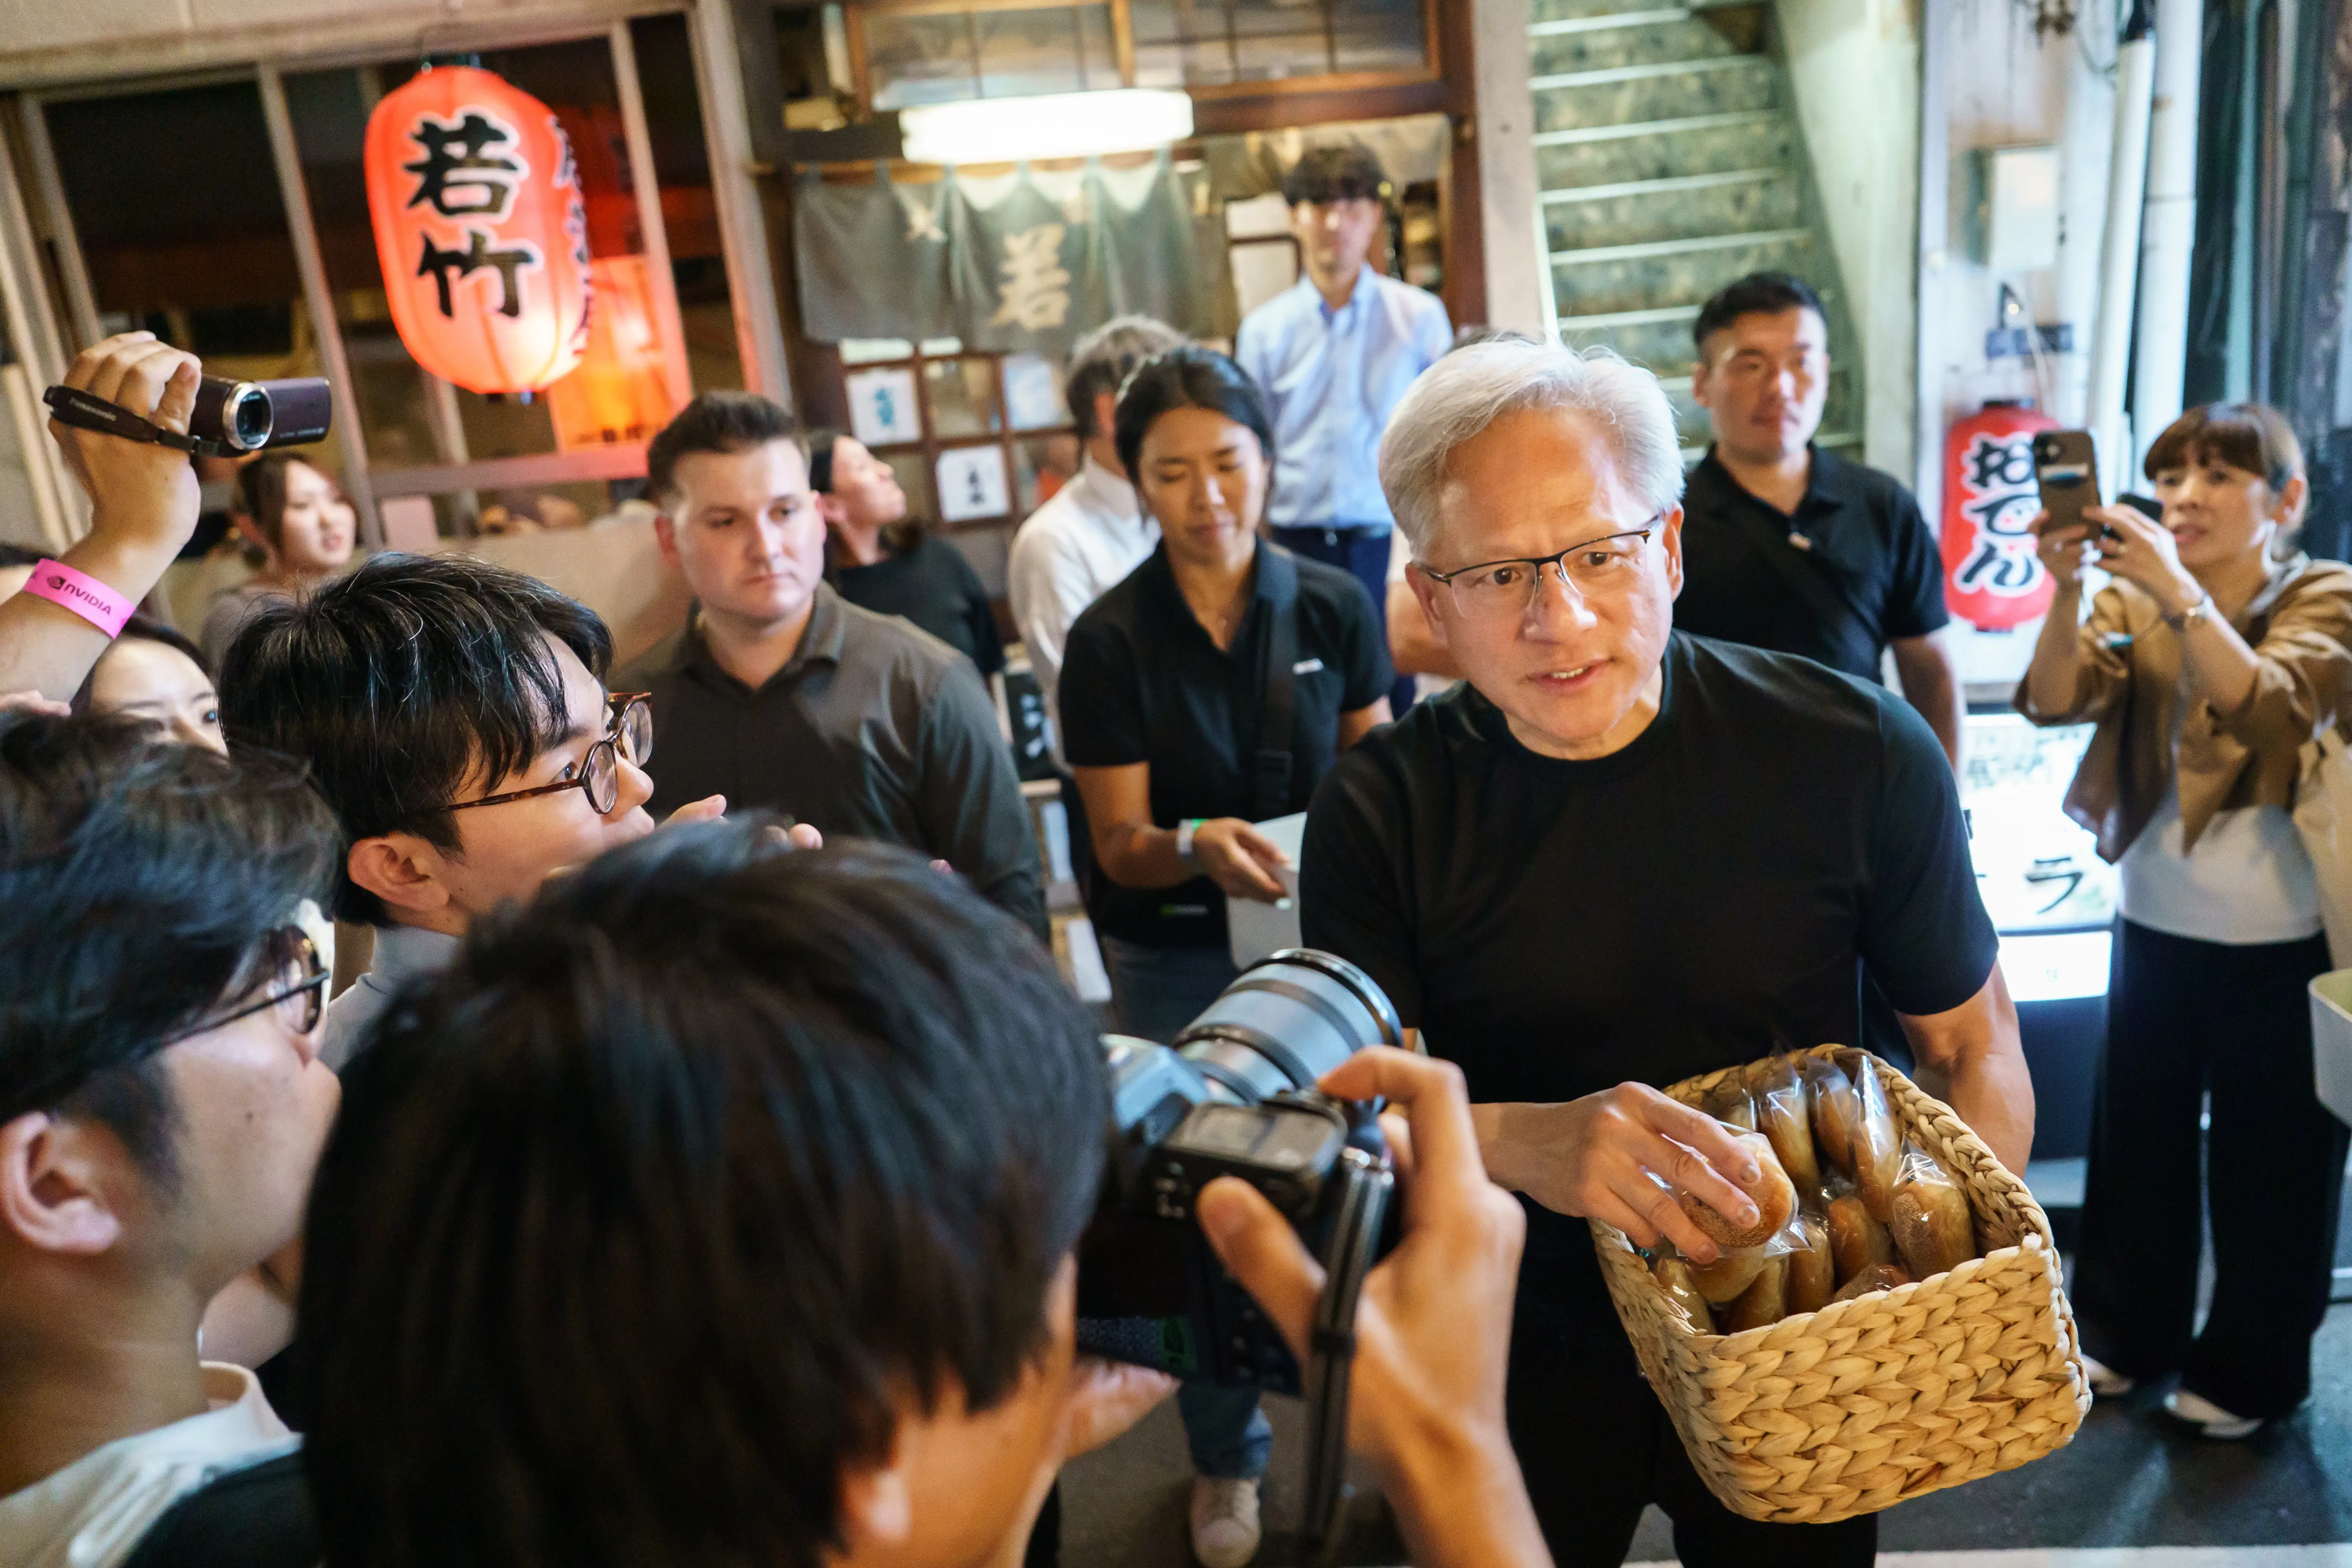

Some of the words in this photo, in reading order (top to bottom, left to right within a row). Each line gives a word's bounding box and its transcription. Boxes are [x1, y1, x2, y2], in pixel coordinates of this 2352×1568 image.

[403, 115, 535, 319] 若竹
[1962, 440, 2039, 586] おでん
